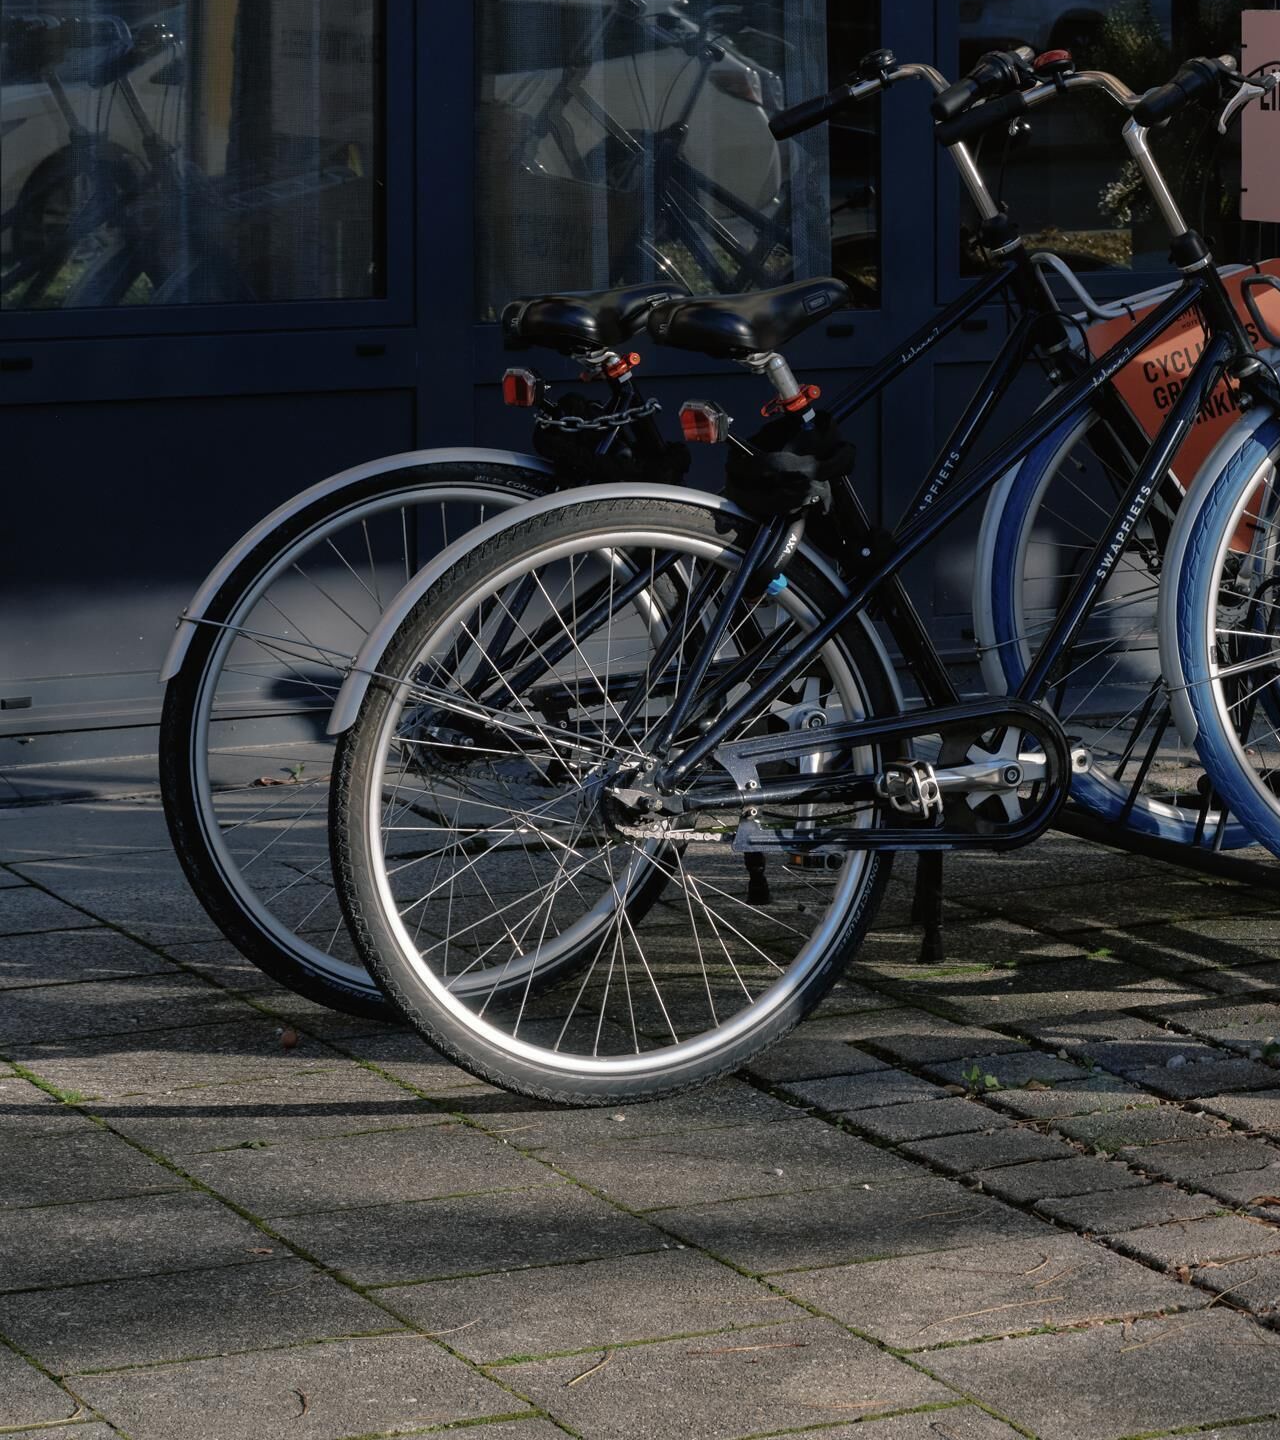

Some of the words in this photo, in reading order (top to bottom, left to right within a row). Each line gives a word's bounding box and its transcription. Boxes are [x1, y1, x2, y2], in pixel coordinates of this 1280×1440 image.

[914, 451, 961, 517] APFIETS
[782, 533, 797, 554] AXA
[1095, 484, 1152, 580] SWAPFIETS
